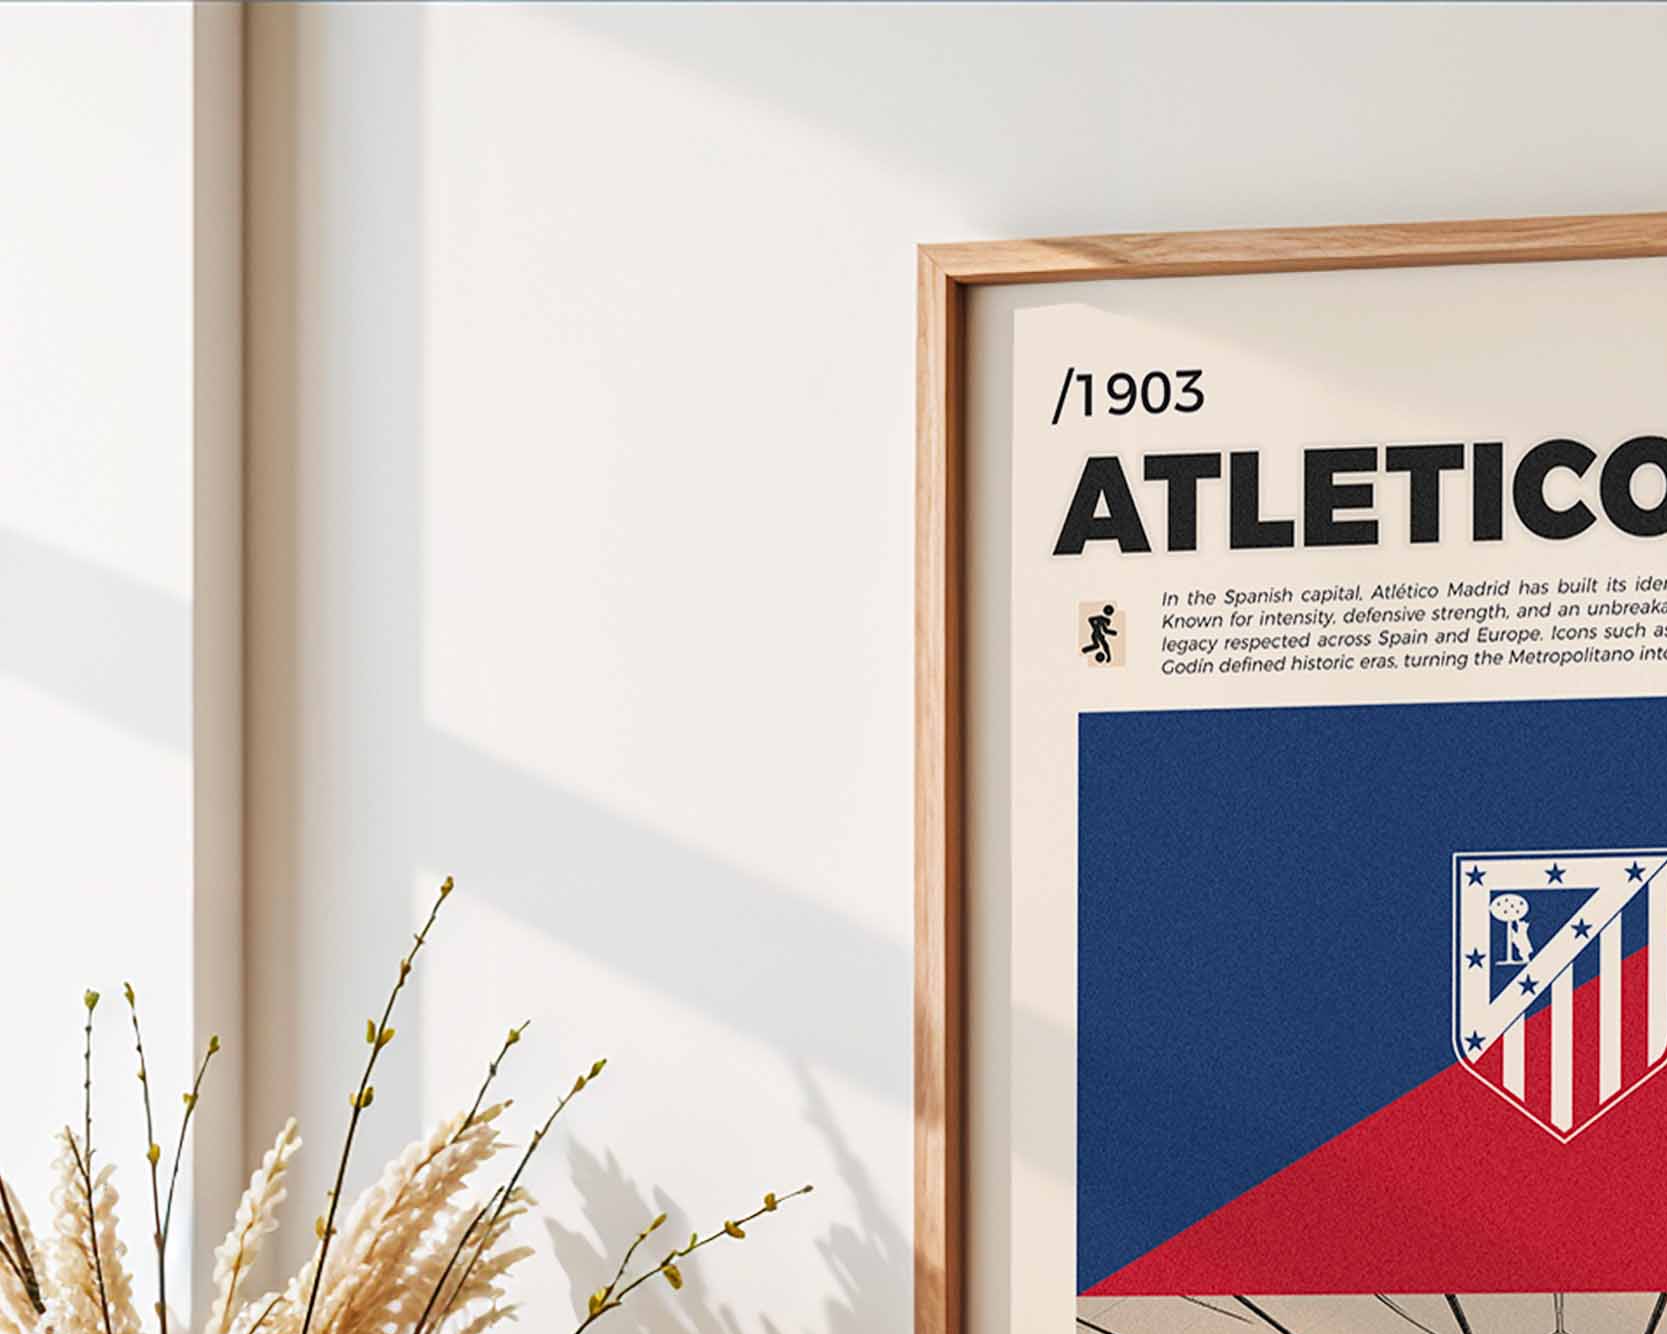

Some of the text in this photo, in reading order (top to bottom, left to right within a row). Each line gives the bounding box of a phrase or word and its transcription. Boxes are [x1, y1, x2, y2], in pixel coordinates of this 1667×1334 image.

[1052, 367, 1205, 425] /1903
[1161, 591, 1180, 607] In
[1186, 589, 1217, 607] the
[1223, 586, 1294, 607] Spanish
[1370, 582, 1440, 601] Atlético
[1446, 579, 1511, 598] Madrid
[1518, 579, 1550, 596] has
[1557, 576, 1599, 595] built
[1605, 576, 1627, 593] its
[1161, 613, 1224, 630] Known
[1229, 610, 1255, 628] for
[1342, 605, 1427, 625] defensive
[1431, 602, 1510, 623] strength,
[1516, 601, 1552, 620] and
[1557, 603, 1581, 618] an
[1161, 635, 1219, 655] legacy
[1223, 631, 1312, 653] respected
[1316, 633, 1372, 648] across
[1377, 628, 1429, 649] Spain
[1434, 627, 1471, 645] and
[1550, 625, 1598, 641] Icons
[1603, 621, 1647, 640] such
[1218, 655, 1287, 674] defined
[1290, 653, 1355, 672] historic
[1403, 650, 1469, 670] turning
[1473, 649, 1504, 667] the
[1508, 646, 1635, 667] Metropolitano
